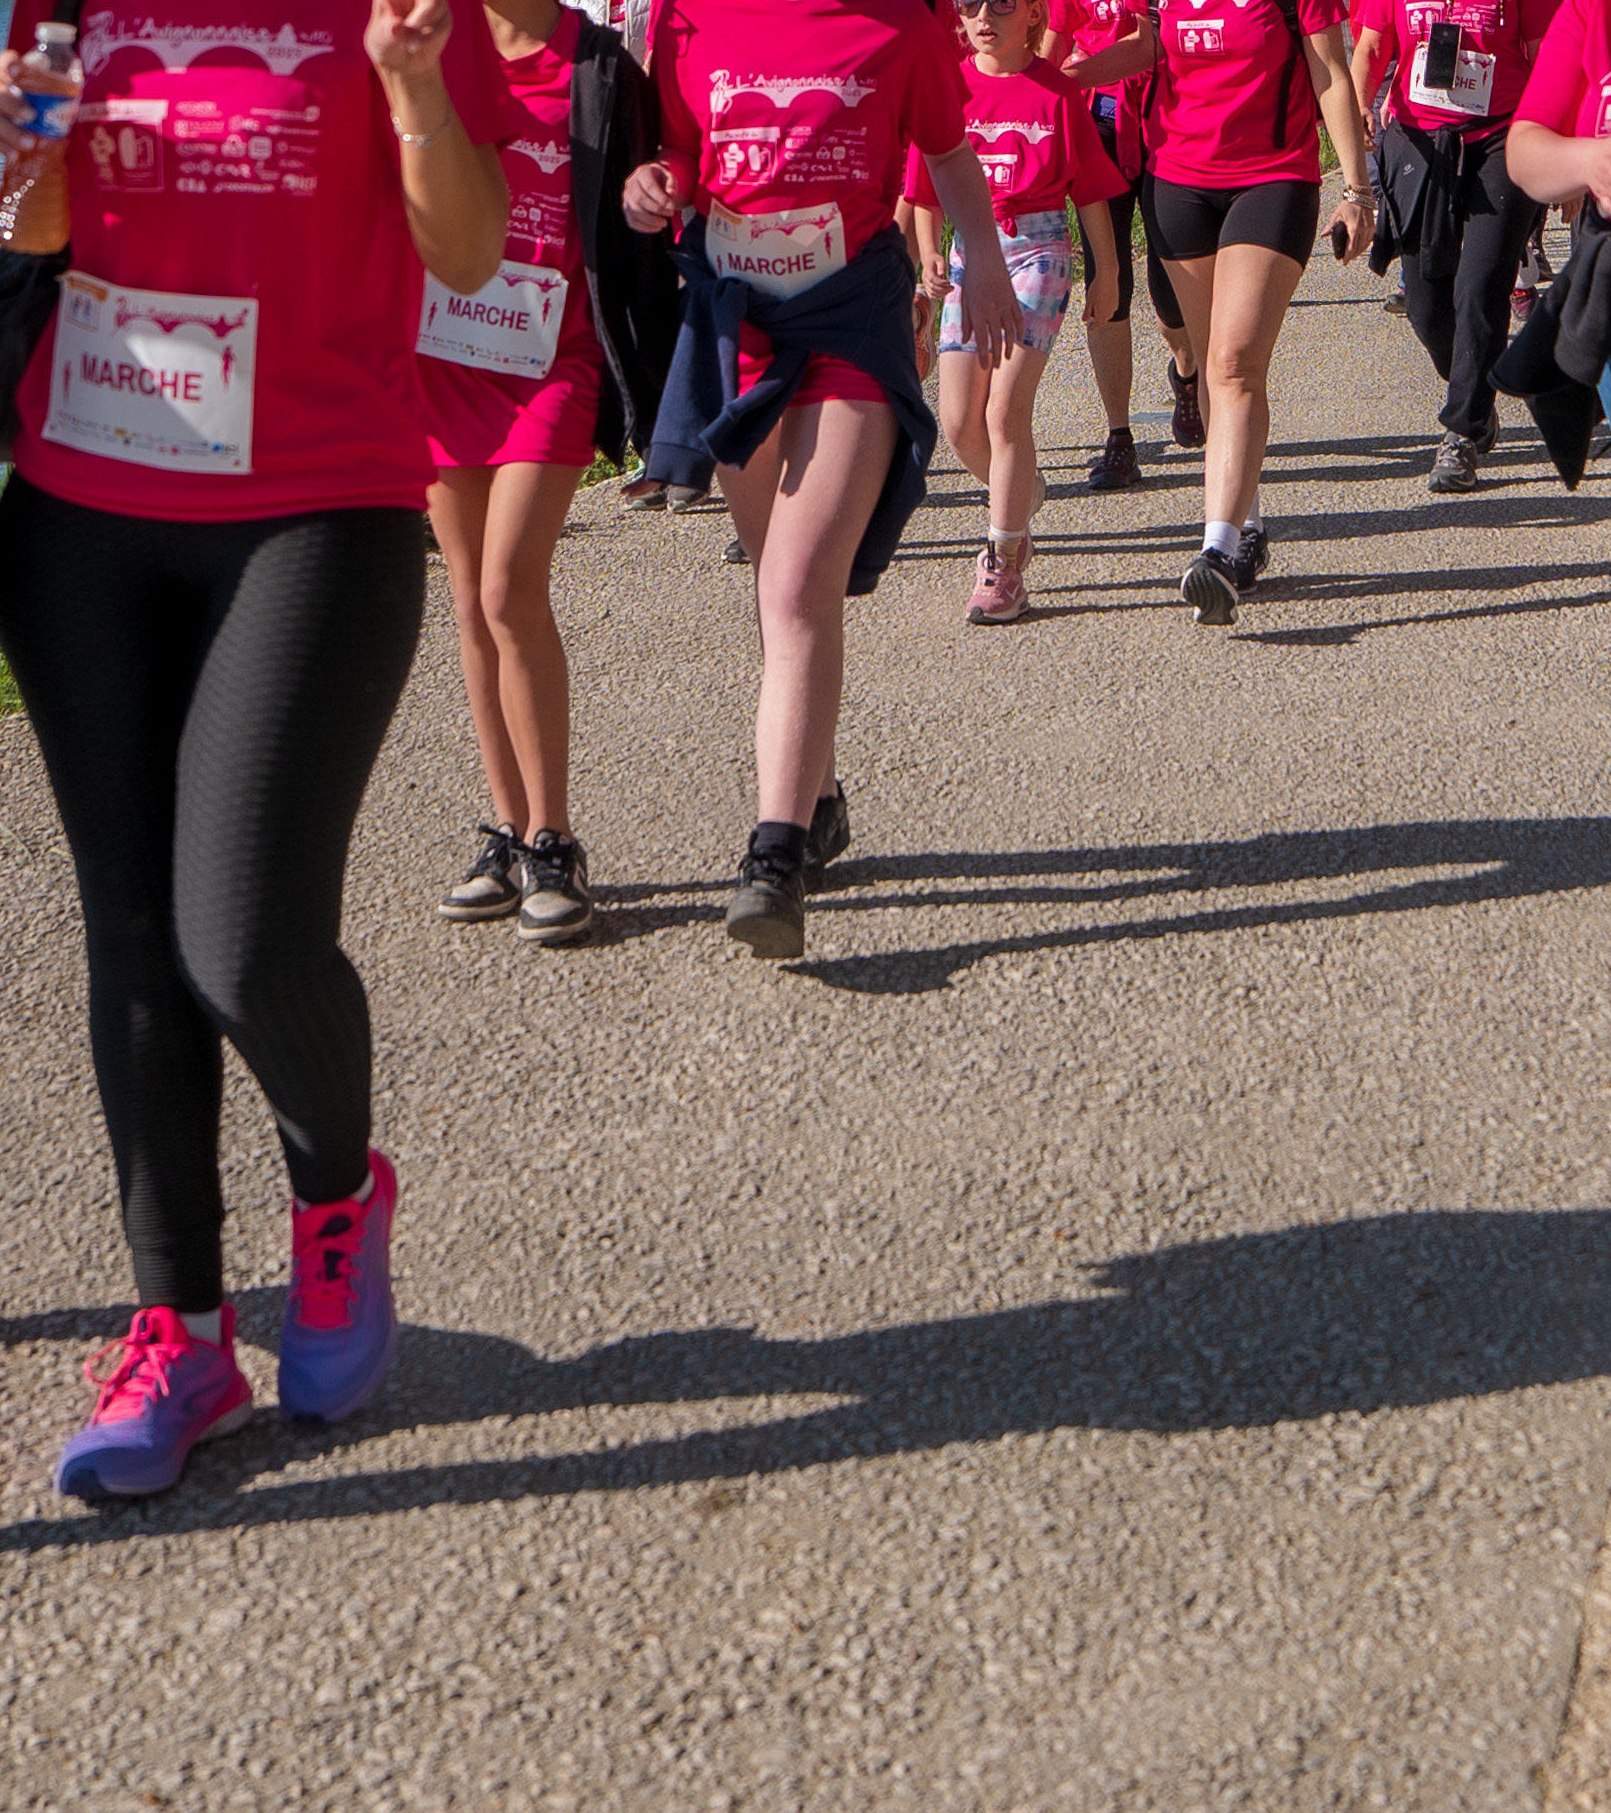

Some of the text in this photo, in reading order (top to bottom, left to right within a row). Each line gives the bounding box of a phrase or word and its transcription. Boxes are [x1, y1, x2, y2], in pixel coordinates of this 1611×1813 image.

[728, 252, 816, 276] MARCHE
[447, 296, 530, 331] MARCHE
[81, 352, 202, 402] MARCHE
